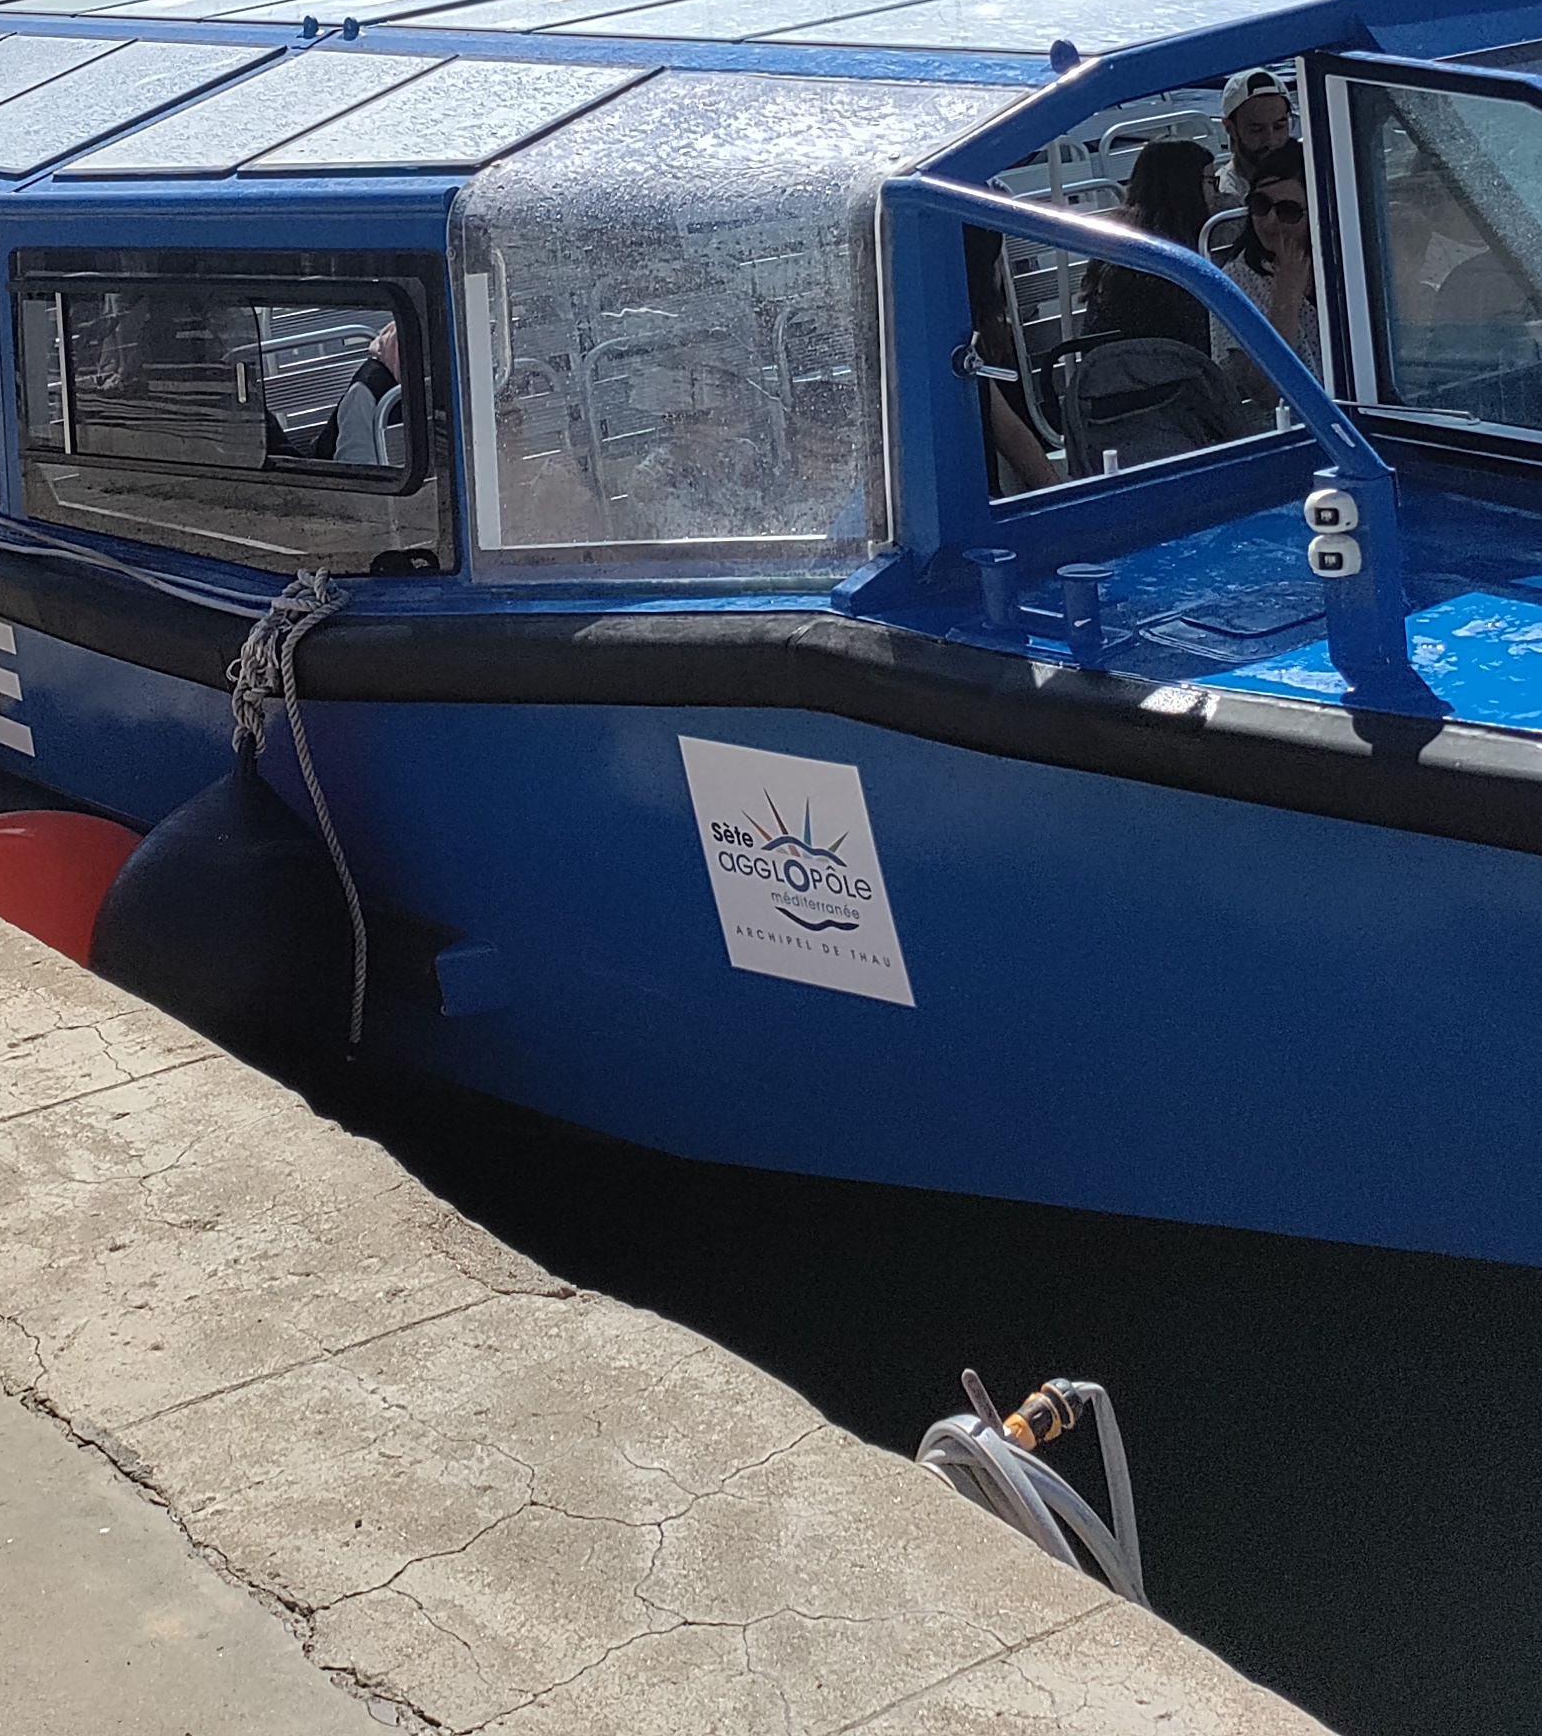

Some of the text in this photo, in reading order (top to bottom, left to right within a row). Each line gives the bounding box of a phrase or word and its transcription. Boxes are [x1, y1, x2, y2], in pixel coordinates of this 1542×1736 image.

[711, 822, 753, 848] Sète
[771, 891, 861, 920] méditerranée
[736, 924, 892, 968] ARCHIPEL DE THAU
